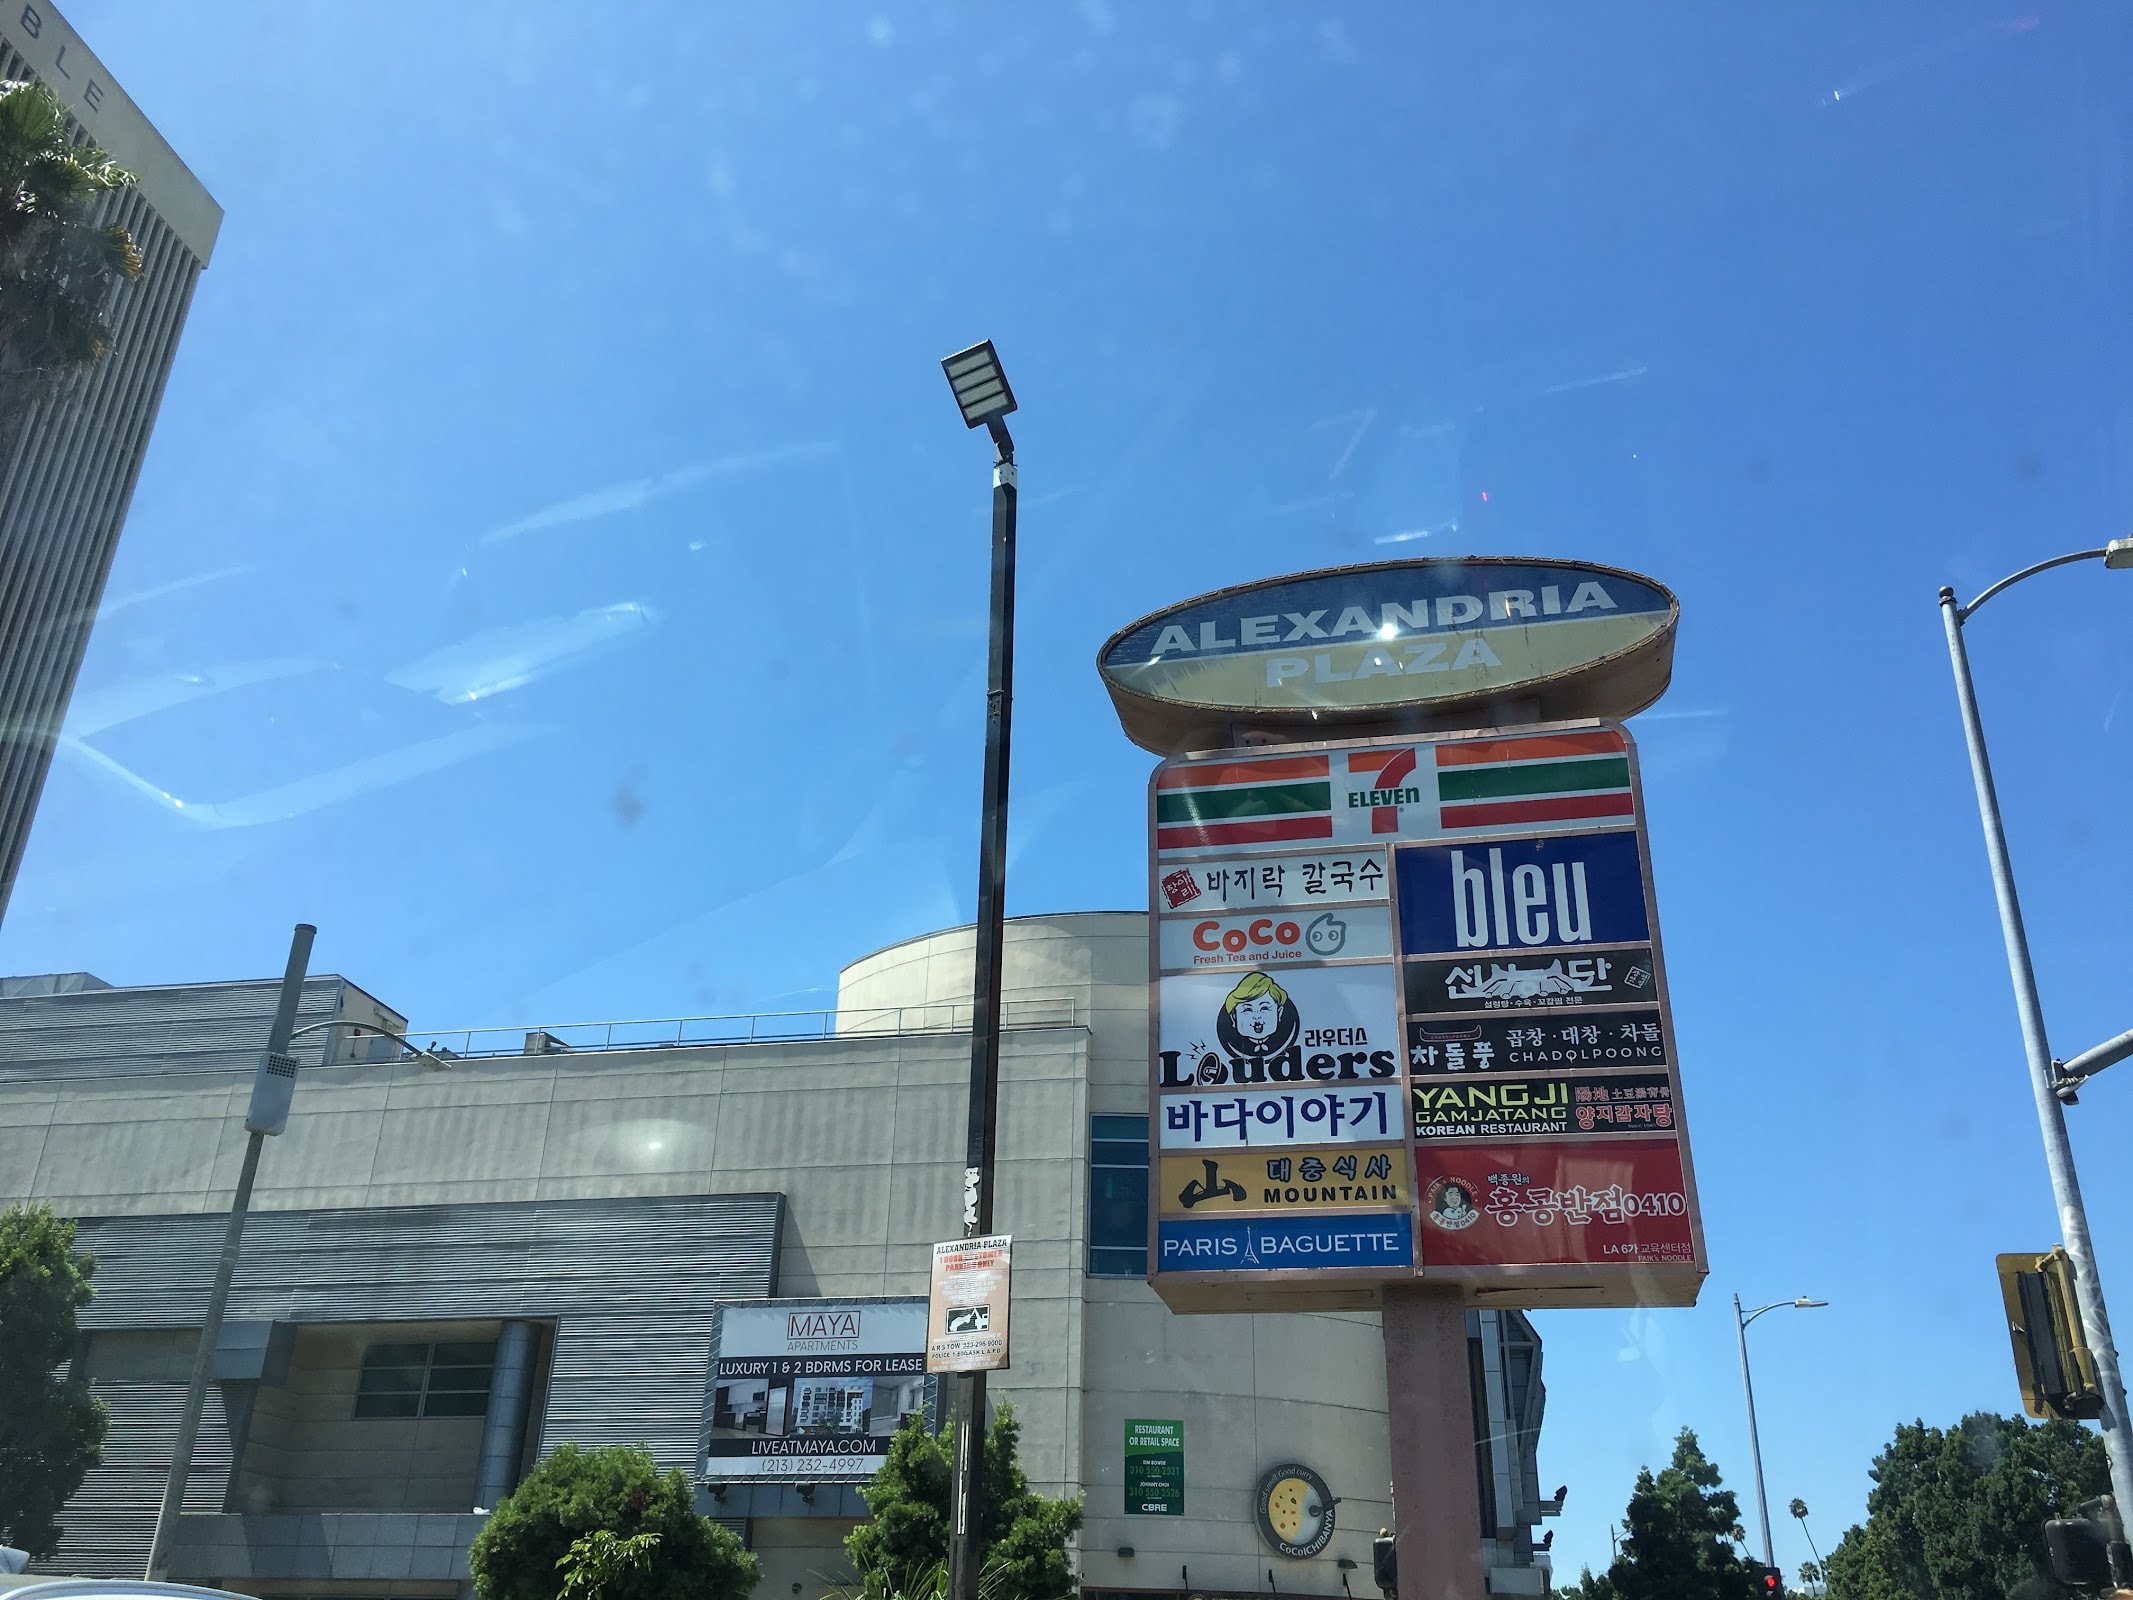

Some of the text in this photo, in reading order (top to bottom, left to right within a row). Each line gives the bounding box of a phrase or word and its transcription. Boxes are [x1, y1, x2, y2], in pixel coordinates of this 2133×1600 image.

[1151, 581, 1618, 655] ALEXANDRIA
[1266, 637, 1502, 689] PLAZA
[1206, 858, 1384, 902] 바지락 칼국수
[1450, 847, 1592, 948] bleu
[1192, 918, 1301, 953] CoCo
[1193, 949, 1302, 965] Fresh Tea and Juice
[1565, 996, 1583, 1004] 전문
[1304, 1027, 1368, 1047] 라우더스
[1505, 1022, 1661, 1048] 곱창 대창 차돌
[1410, 1041, 1495, 1071] 차돌풍
[1509, 1045, 1662, 1063] CHADOLPOONG
[1159, 1045, 1396, 1087] Louders
[1413, 1082, 1569, 1109] YANGJI
[1166, 1092, 1388, 1142] 바다이야기
[1416, 1106, 1567, 1124] GAMJATANG
[1576, 1103, 1673, 1130] 양지감자탕
[1416, 1121, 1568, 1136] KOREAN RESTAURANT
[1266, 1153, 1392, 1183] 대중식사
[1450, 1176, 1479, 1197] NOODLE
[1487, 1173, 1530, 1186] 백종원의
[1264, 1185, 1397, 1203] MOUNTAIN
[1484, 1184, 1688, 1227] 홍콩반점0410
[937, 1239, 1007, 1255] ALEXANDRIA PLAZA
[1164, 1232, 1399, 1256] PARIS BAGUETTE
[1603, 1242, 1692, 1255] LA 6가 교육센터점
[1661, 1254, 1692, 1262] NOODLE
[791, 1314, 856, 1337] MAYA
[787, 1340, 858, 1351] APARTMENTS
[720, 1362, 769, 1375] LUXURY
[772, 1362, 777, 1373] 1
[781, 1361, 790, 1373] &
[794, 1361, 801, 1373] 2
[806, 1360, 851, 1373] BDRMS
[855, 1360, 881, 1371] FOR
[886, 1359, 922, 1371] LEASE
[1135, 1425, 1173, 1434] RESTAURANT
[752, 1440, 876, 1454] LIVEATMAYA.COM
[1129, 1437, 1179, 1446] OR RETAIL SPACE
[762, 1459, 864, 1472] (213) 232-4997
[1130, 1466, 1144, 1474] 310
[1162, 1467, 1179, 1475] 2521
[1278, 1467, 1295, 1477] Good
[1296, 1470, 1313, 1480] curry
[1129, 1488, 1143, 1496] 310
[1162, 1489, 1179, 1497] 2526
